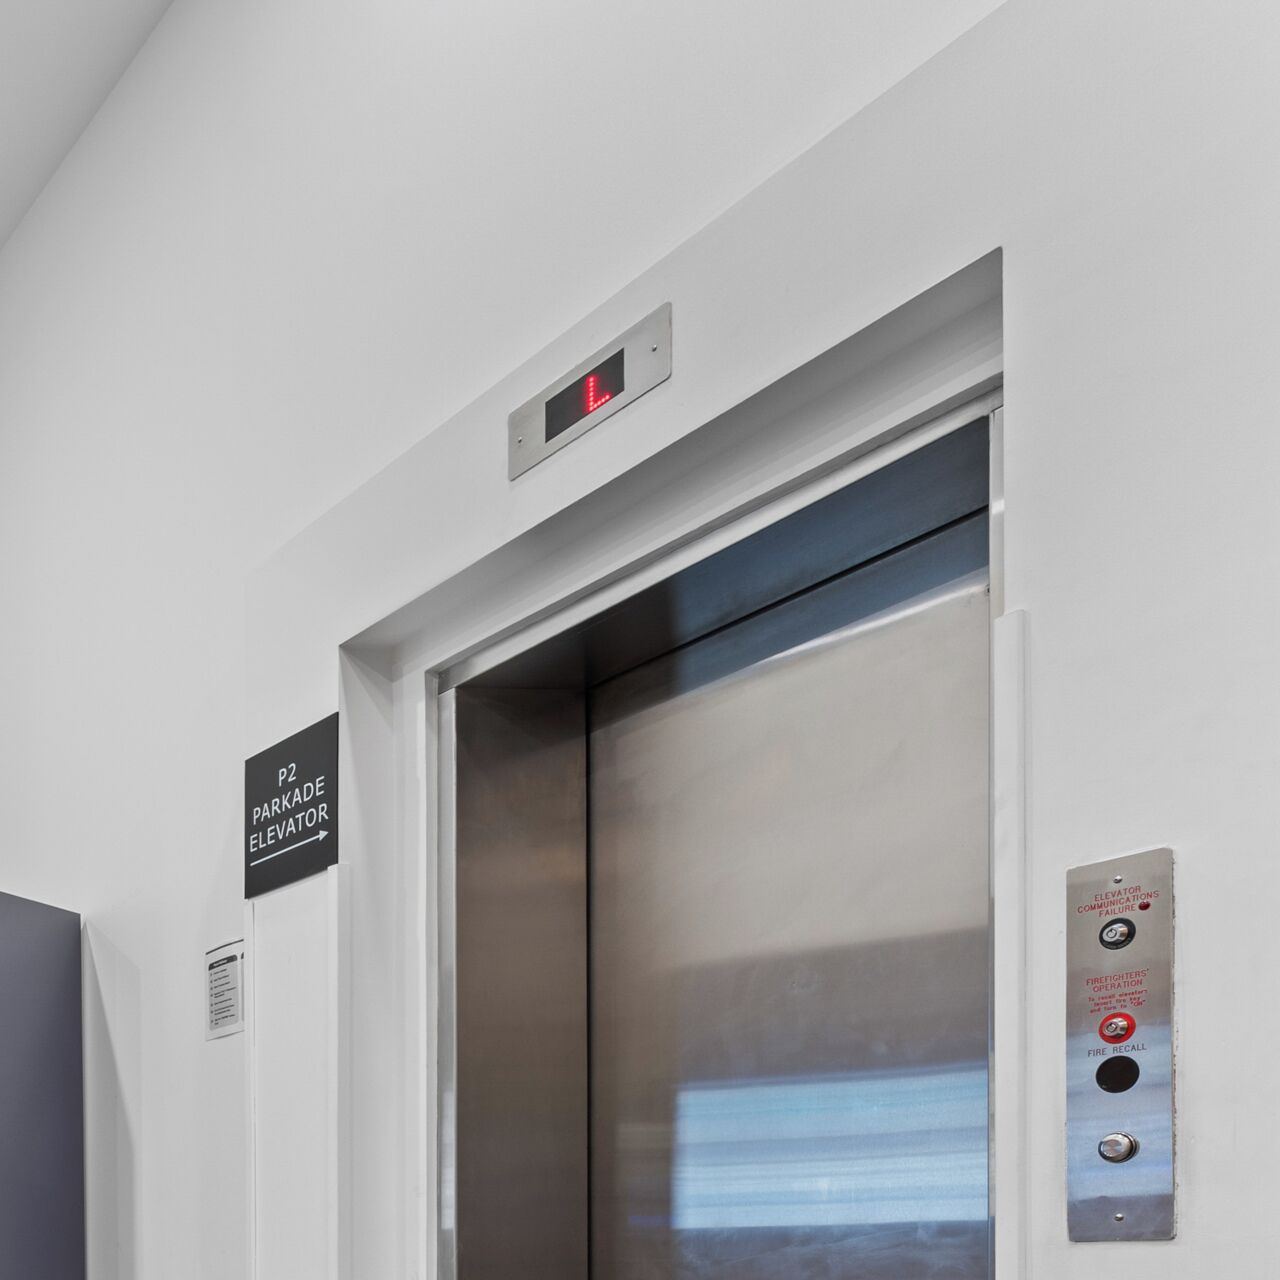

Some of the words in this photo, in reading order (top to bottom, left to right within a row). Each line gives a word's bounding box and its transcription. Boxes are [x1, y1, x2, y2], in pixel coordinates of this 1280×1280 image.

[589, 375, 611, 413] L
[278, 762, 297, 787] P2
[252, 775, 326, 825] PARKADE
[249, 803, 329, 853] ELEVATOR
[1077, 890, 1160, 914] COMMUNICATIONS
[1094, 885, 1142, 902] ELEVATOR
[1098, 903, 1137, 917] FAILURE
[1092, 979, 1143, 993] OPERATION
[1087, 1047, 1108, 1057] FIRE
[1112, 1043, 1147, 1055] RECALL
